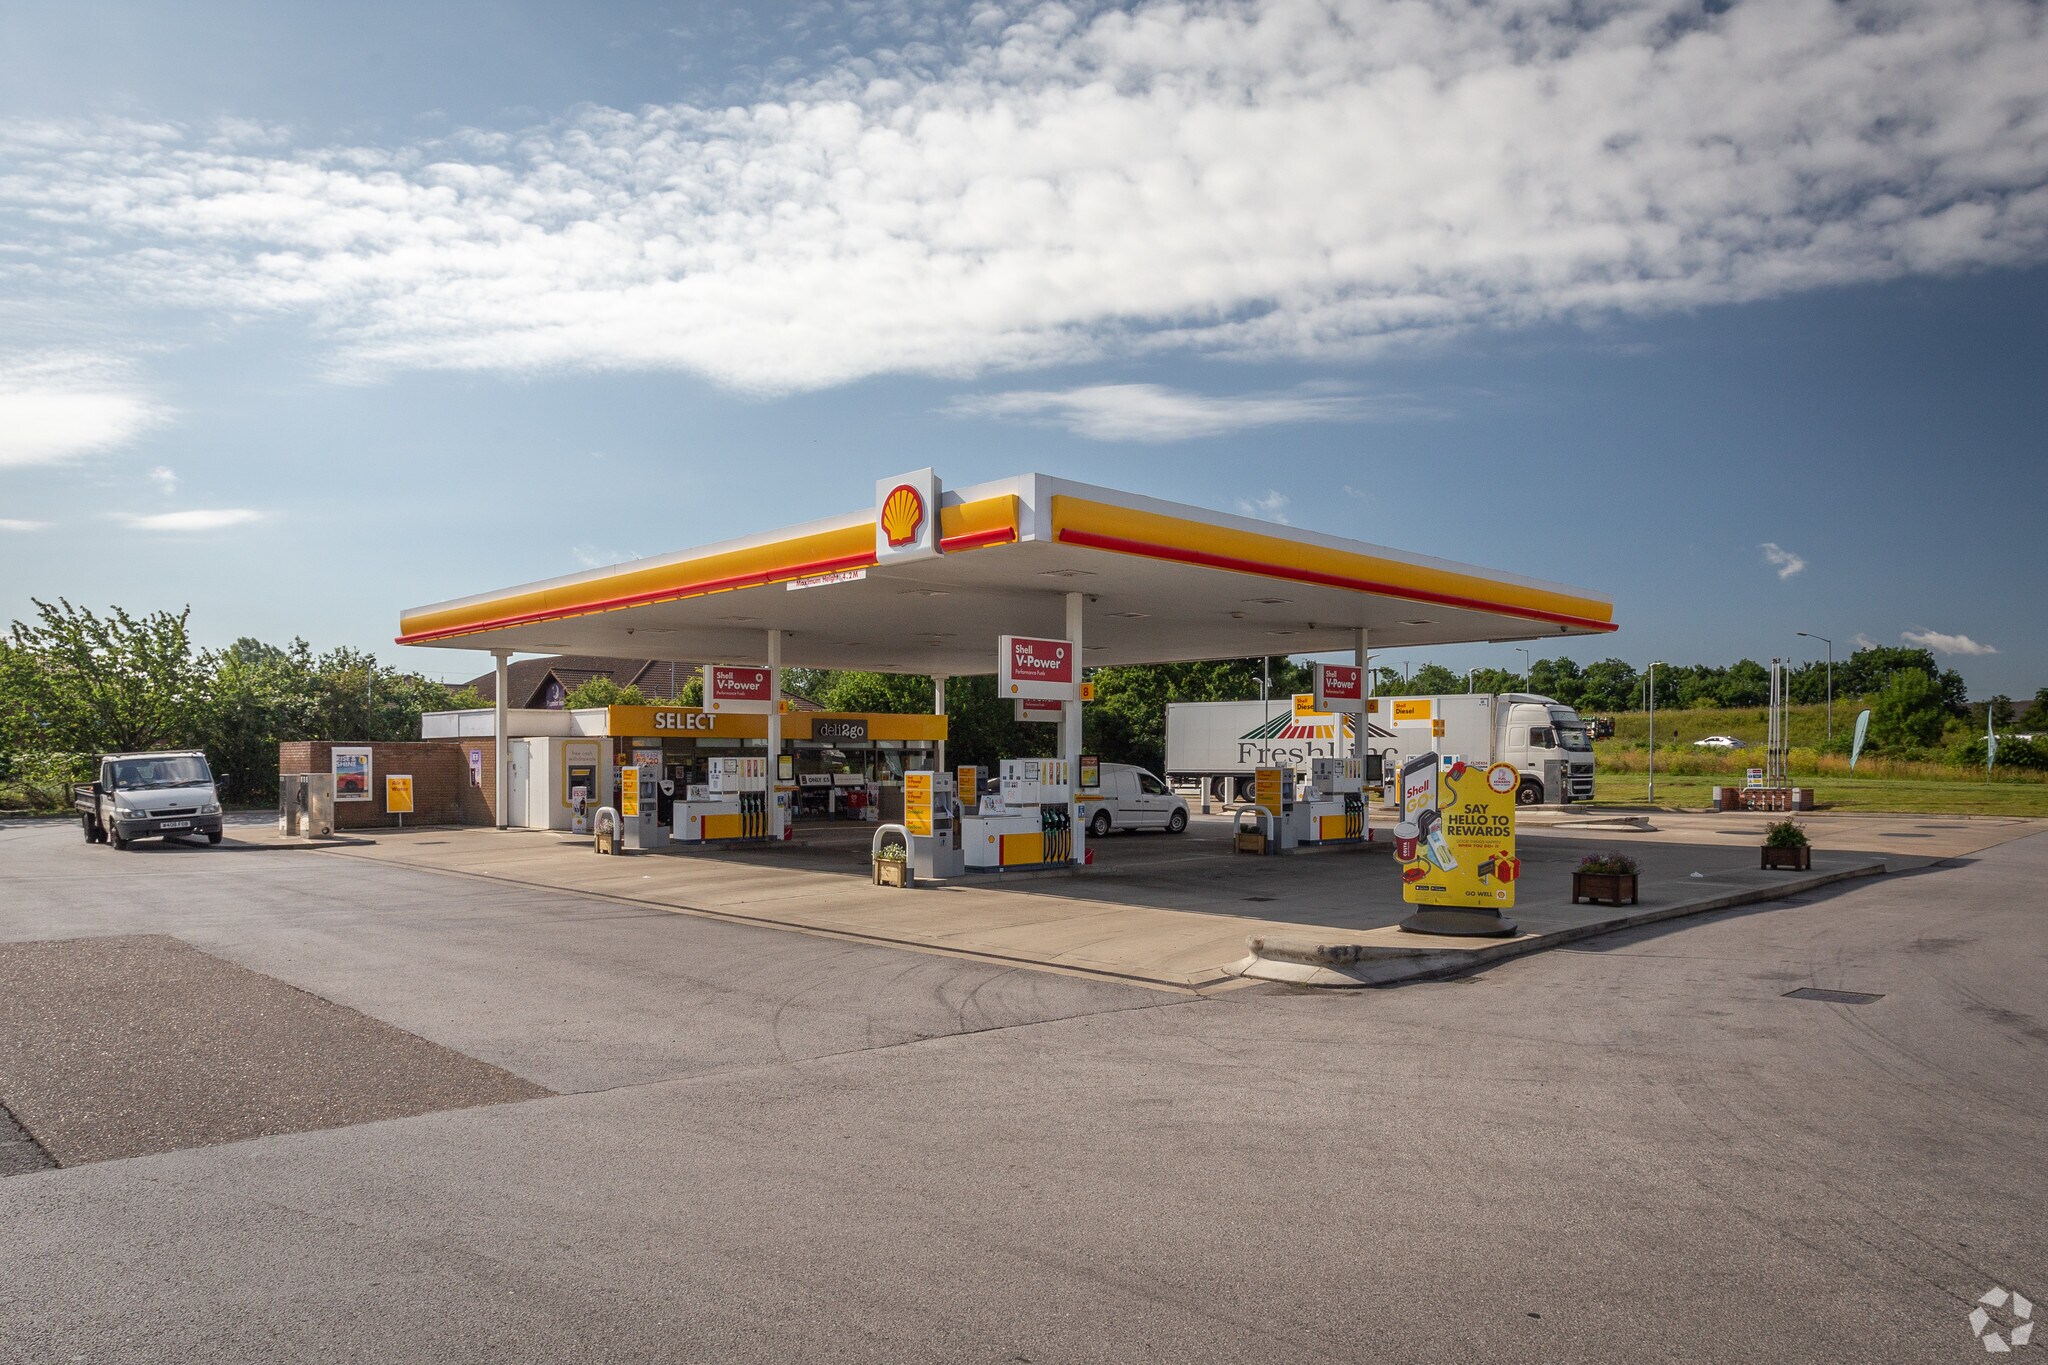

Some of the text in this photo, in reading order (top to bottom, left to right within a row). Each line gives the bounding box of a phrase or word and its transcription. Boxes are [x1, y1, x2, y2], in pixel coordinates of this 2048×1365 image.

[796, 571, 859, 586] Maximum Height 4.2M
[1015, 644, 1033, 654] Shell
[1016, 655, 1061, 669] V-Power
[1326, 670, 1337, 678] Shell
[717, 680, 760, 690] V-Power
[1326, 678, 1355, 689] V-Power
[1083, 687, 1089, 696] 8
[655, 712, 716, 729] SELECT
[820, 723, 864, 739] deli2go
[1407, 779, 1429, 799] Shell
[1406, 793, 1435, 813] GO+
[1464, 804, 1489, 814] SAY
[1448, 815, 1509, 825] HELLO TO
[1447, 826, 1511, 836] REWARDS
